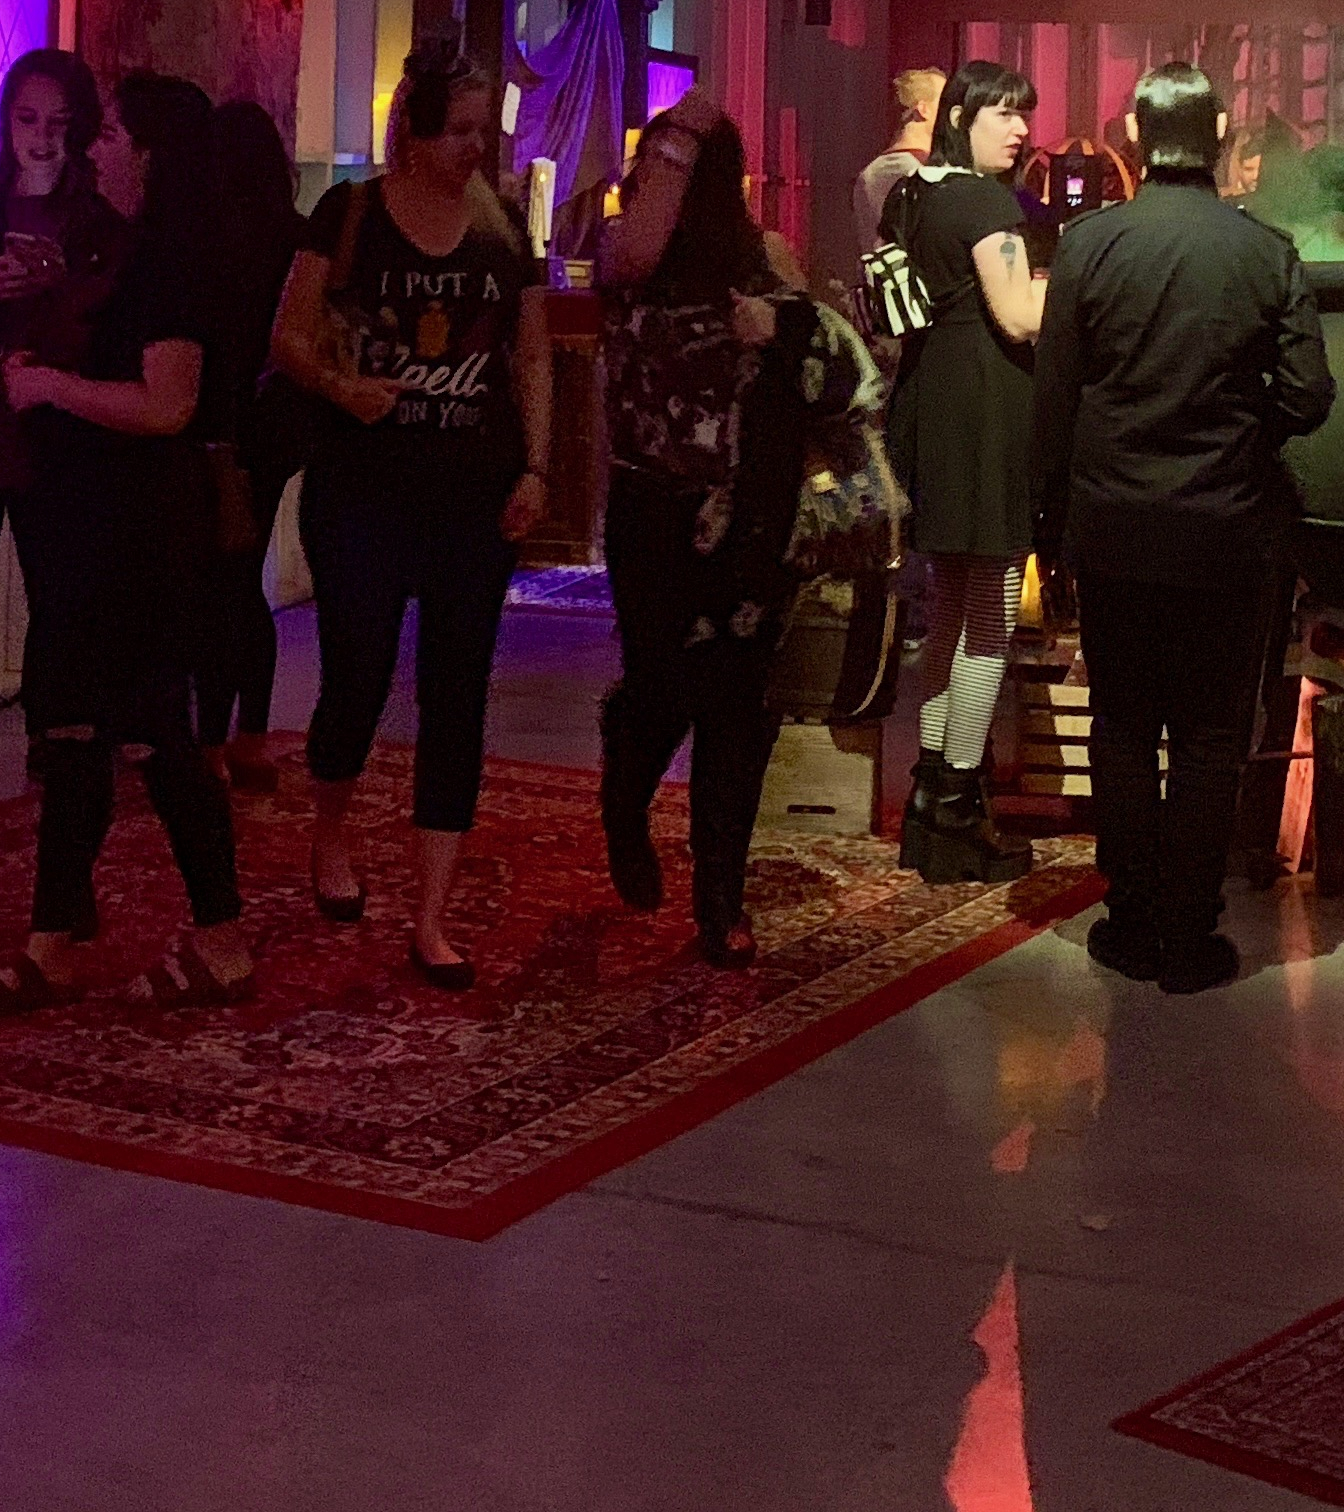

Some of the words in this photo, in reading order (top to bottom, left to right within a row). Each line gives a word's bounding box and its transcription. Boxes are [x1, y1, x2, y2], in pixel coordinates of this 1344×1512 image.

[380, 271, 390, 296] I
[406, 271, 467, 298] PUT
[482, 272, 500, 301] A
